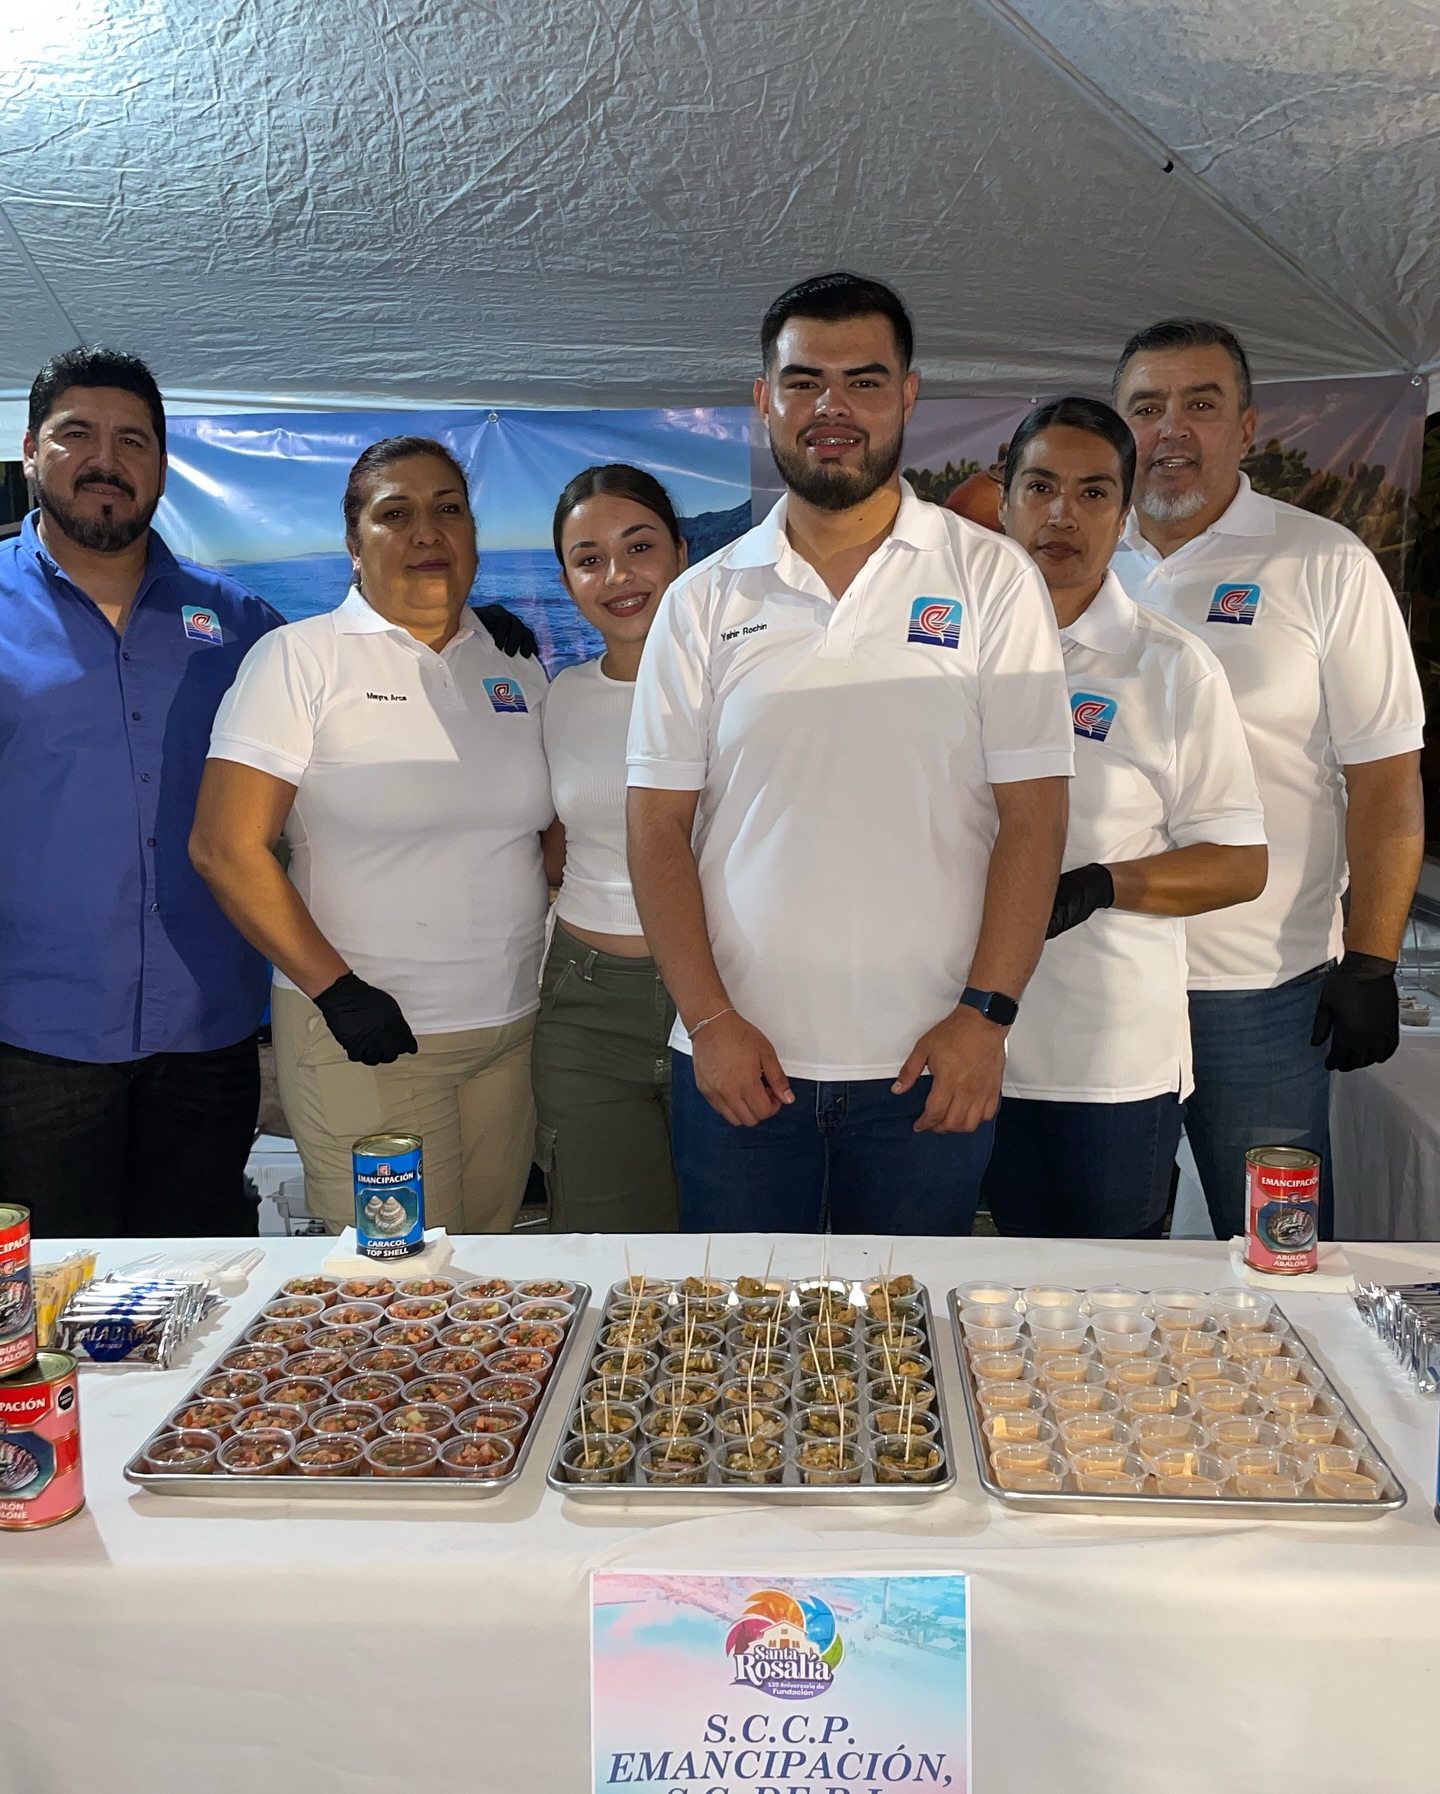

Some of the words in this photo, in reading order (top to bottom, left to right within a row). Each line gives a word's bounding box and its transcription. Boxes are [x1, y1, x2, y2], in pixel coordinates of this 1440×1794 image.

[357, 1171, 414, 1184] EMANCIPACIÓN
[367, 1239, 407, 1247] CARACOL
[366, 1249, 383, 1257] TOP
[383, 1247, 409, 1257] SHELL
[754, 1645, 799, 1661] Santa
[735, 1653, 832, 1686] Rosalía
[772, 1688, 814, 1696] Fundación
[780, 1681, 816, 1690] Aniversario
[703, 1713, 855, 1745] S.C.C.P.
[606, 1744, 953, 1788] EMANCIPACIÓN,
